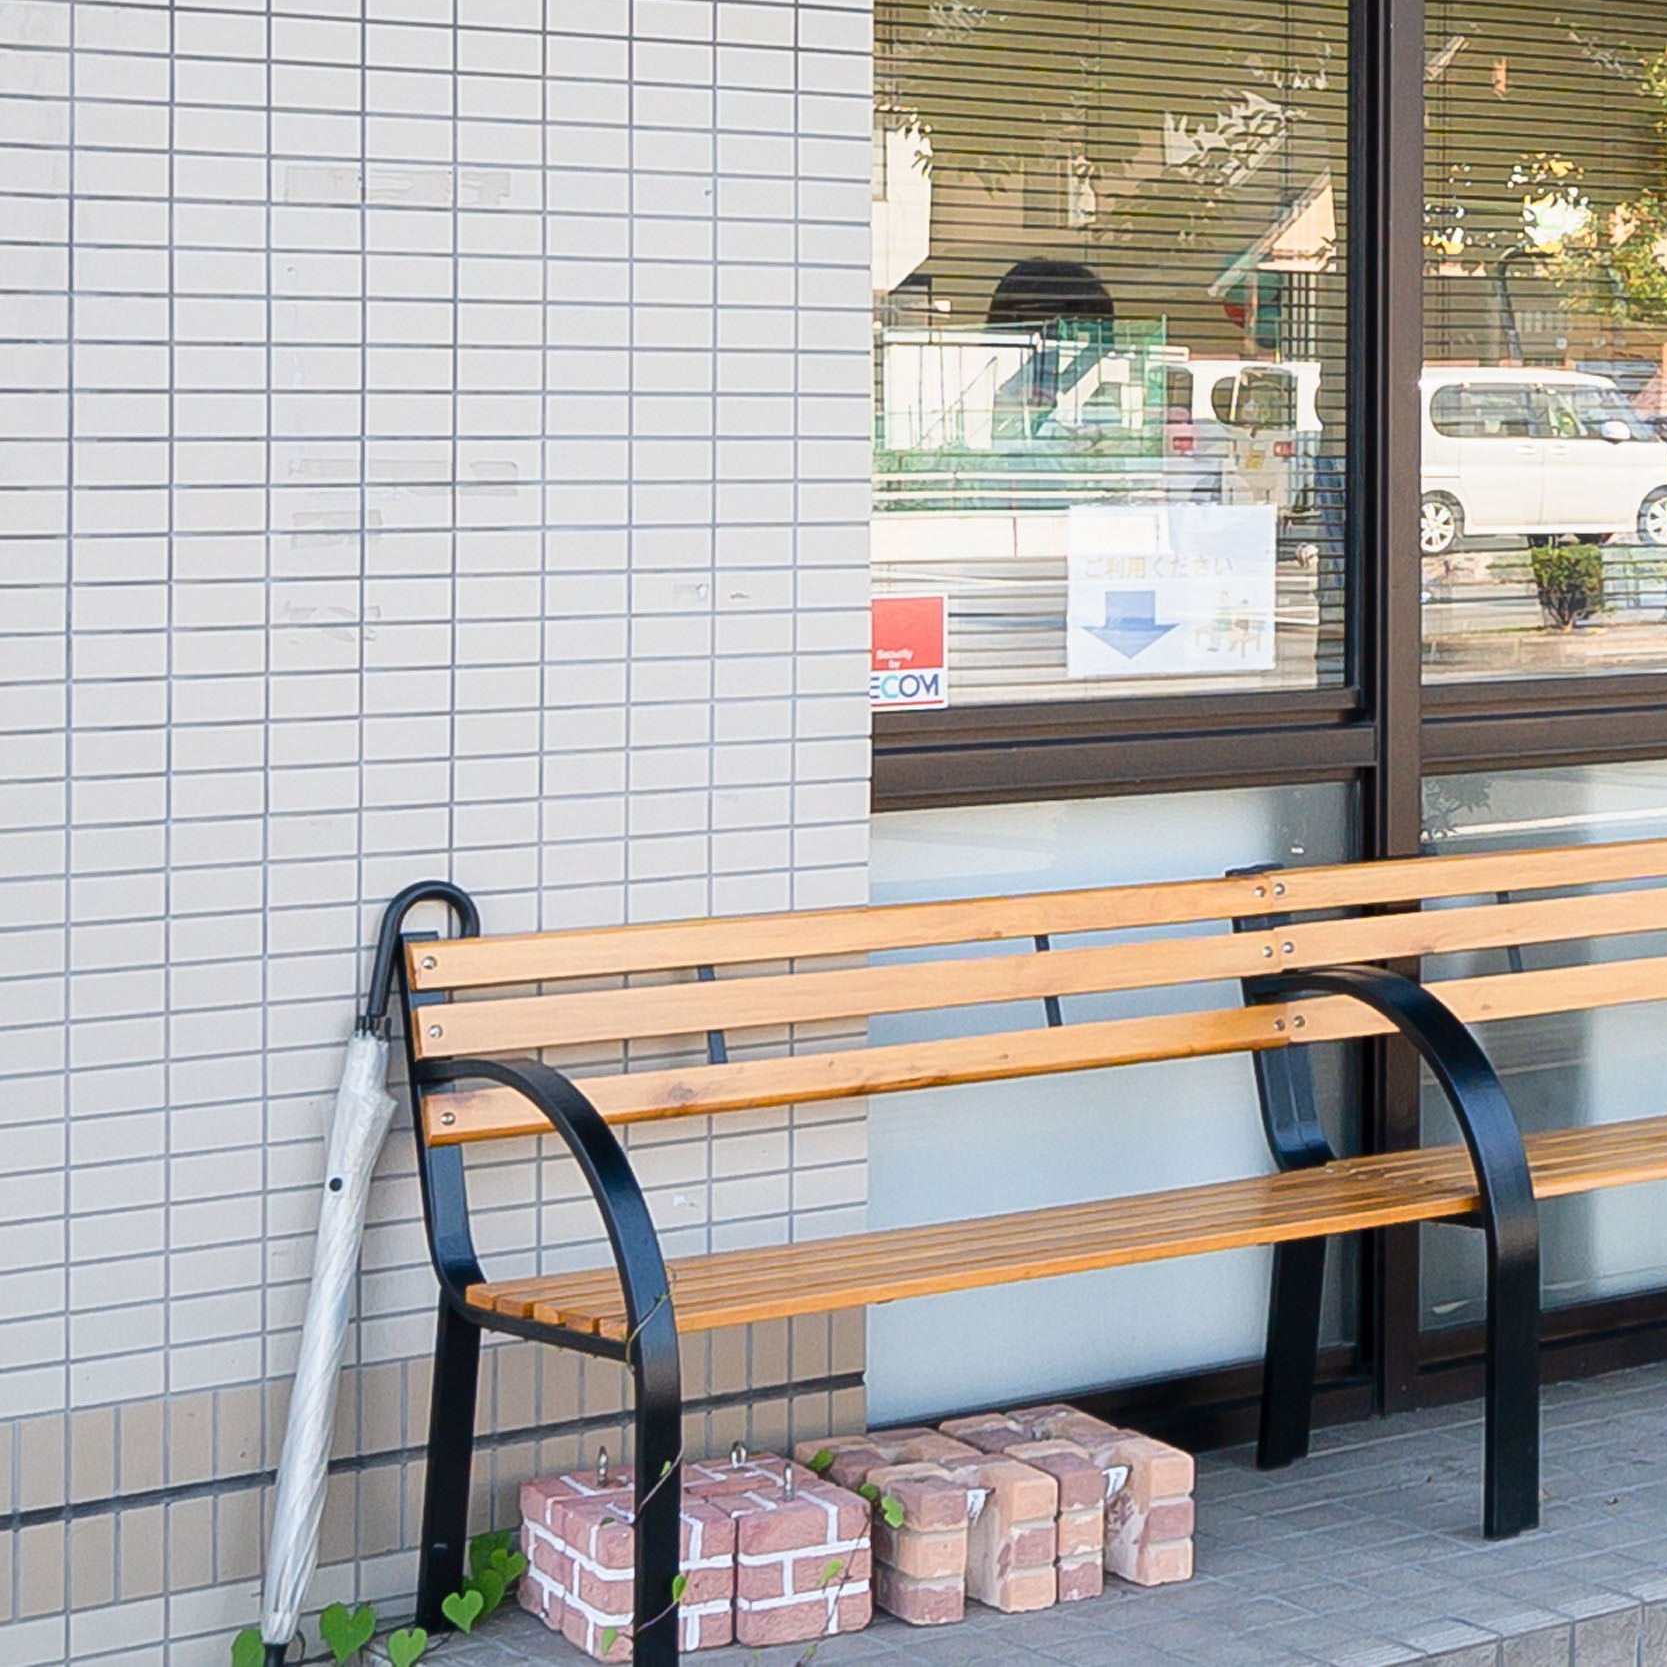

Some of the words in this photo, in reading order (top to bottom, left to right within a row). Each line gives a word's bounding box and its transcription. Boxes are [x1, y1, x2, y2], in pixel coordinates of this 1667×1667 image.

[1085, 556, 1234, 580] ご利用ください
[869, 673, 940, 700] ECOM
